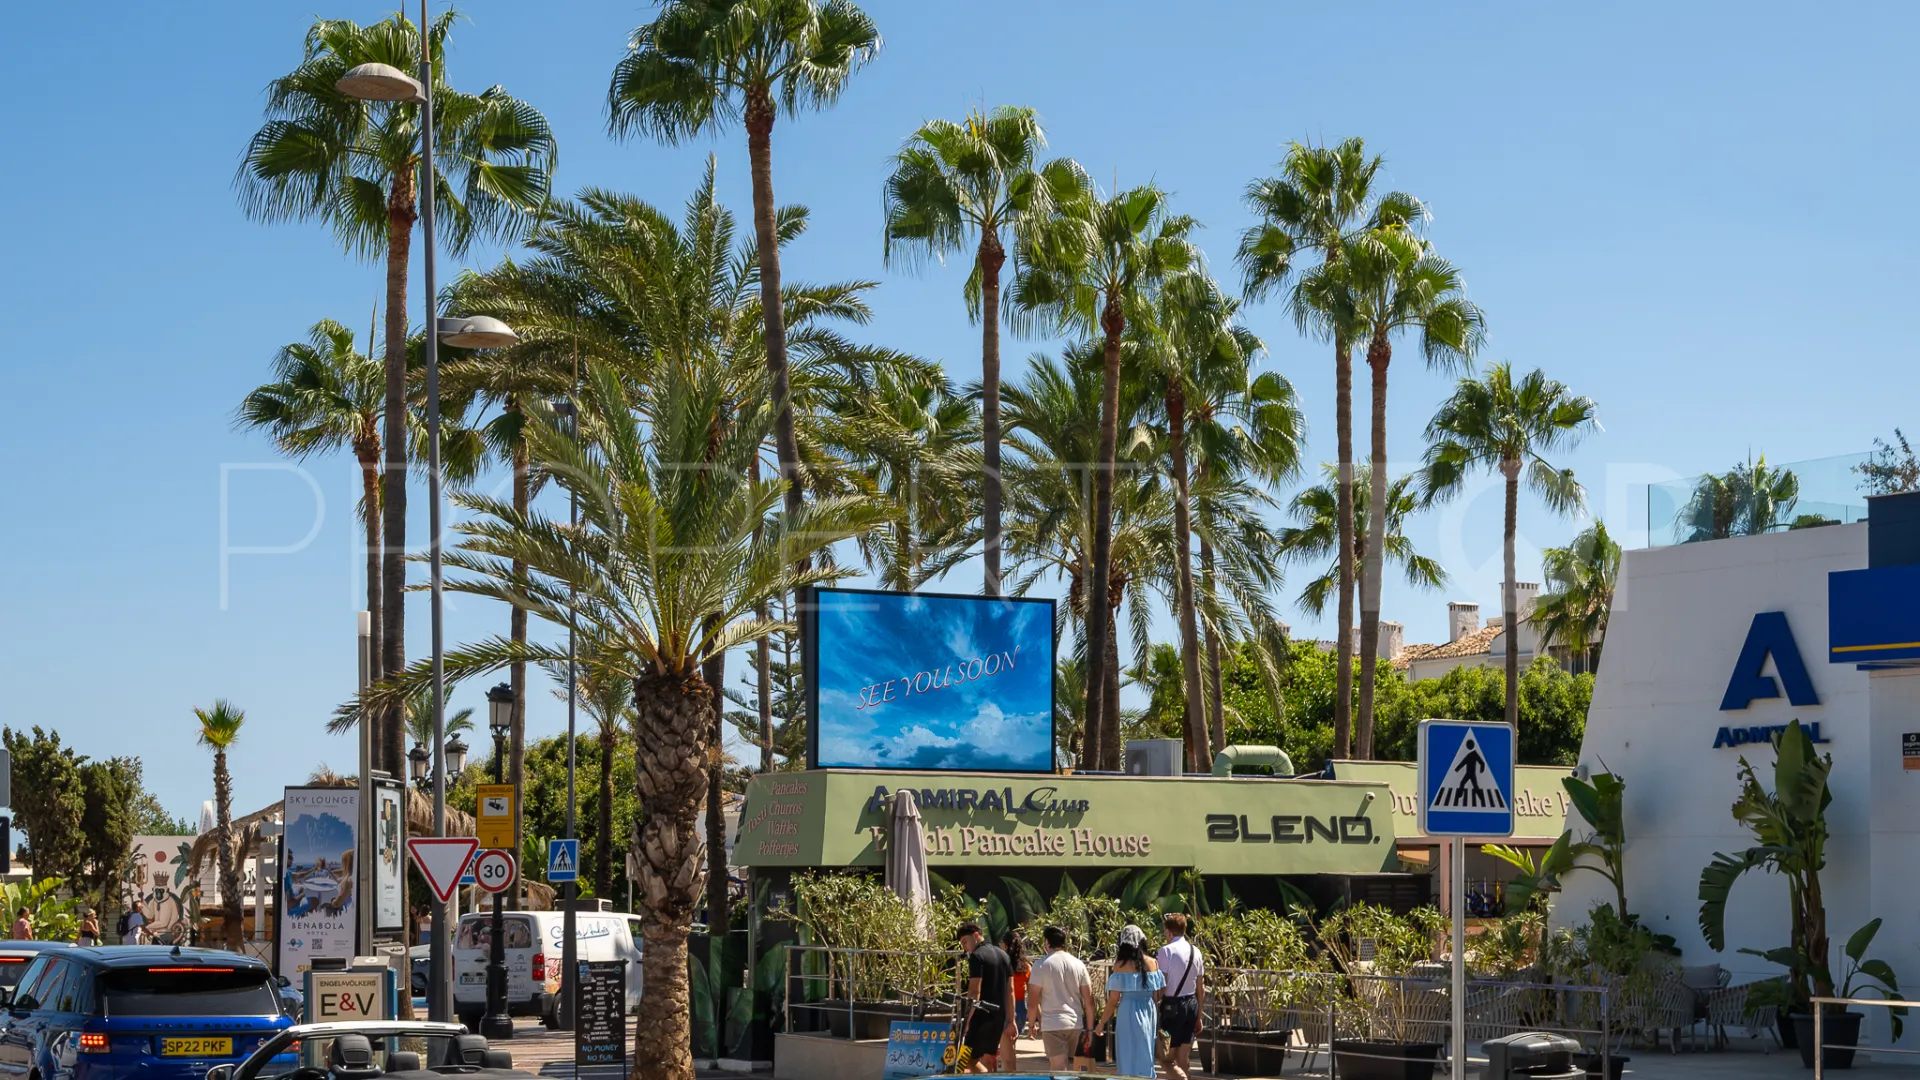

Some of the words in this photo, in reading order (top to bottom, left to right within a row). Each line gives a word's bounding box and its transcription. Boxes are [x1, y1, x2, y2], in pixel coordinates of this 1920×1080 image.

[856, 679, 897, 710] SEE
[901, 665, 952, 698] YOU
[955, 644, 1021, 685] SOON
[771, 779, 808, 796] Pancakes
[289, 796, 307, 804] SKY
[311, 796, 355, 804] LOUNGE
[769, 799, 803, 816] Churros
[746, 804, 768, 834] Tosti
[767, 820, 798, 836] Waffles
[758, 840, 799, 858] Poffertjes
[871, 825, 954, 855] Dch
[961, 826, 1067, 856] Pancake
[1070, 827, 1152, 856] House
[483, 864, 505, 878] 30
[291, 922, 345, 930] BENABOLA
[320, 992, 375, 1016] E&V
[167, 1041, 200, 1052] SP22
[203, 1041, 226, 1052] PKF
